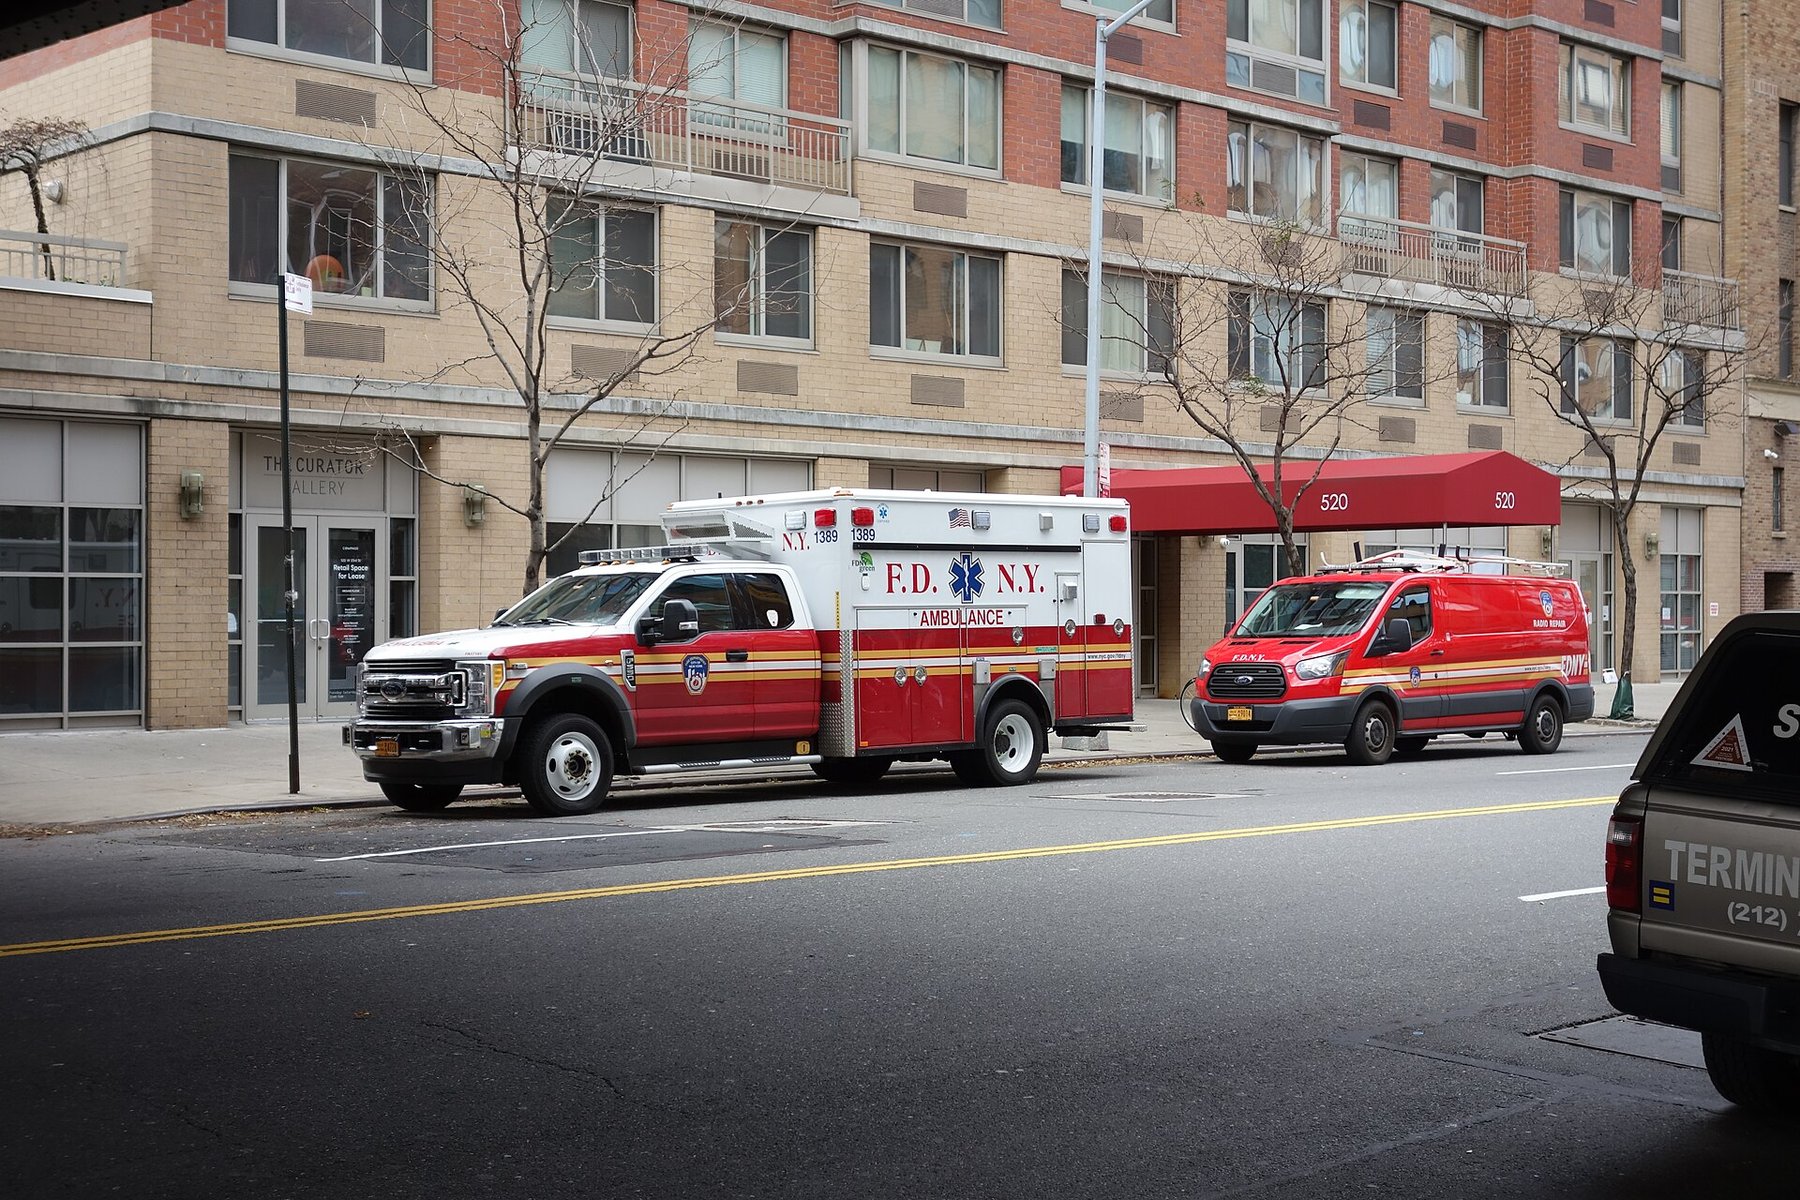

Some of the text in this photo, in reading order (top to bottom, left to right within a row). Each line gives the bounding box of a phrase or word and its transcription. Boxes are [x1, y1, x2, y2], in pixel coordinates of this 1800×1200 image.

[263, 456, 364, 474] TH CURATOR
[289, 479, 345, 495] ALLERY
[1320, 493, 1349, 511] 520
[1495, 492, 1515, 509] 520
[782, 532, 810, 551] N.Y.
[814, 530, 838, 543] 1389
[851, 528, 876, 541] 1389
[351, 564, 369, 572] Space
[886, 563, 1045, 594] F.D. N.Y.
[920, 609, 1004, 627] AMBULANCE
[1533, 619, 1566, 628] RADIO REPAIR
[1561, 654, 1585, 677] FDNY
[1664, 839, 1800, 899] TERMIN
[1727, 901, 1787, 932] (212)
